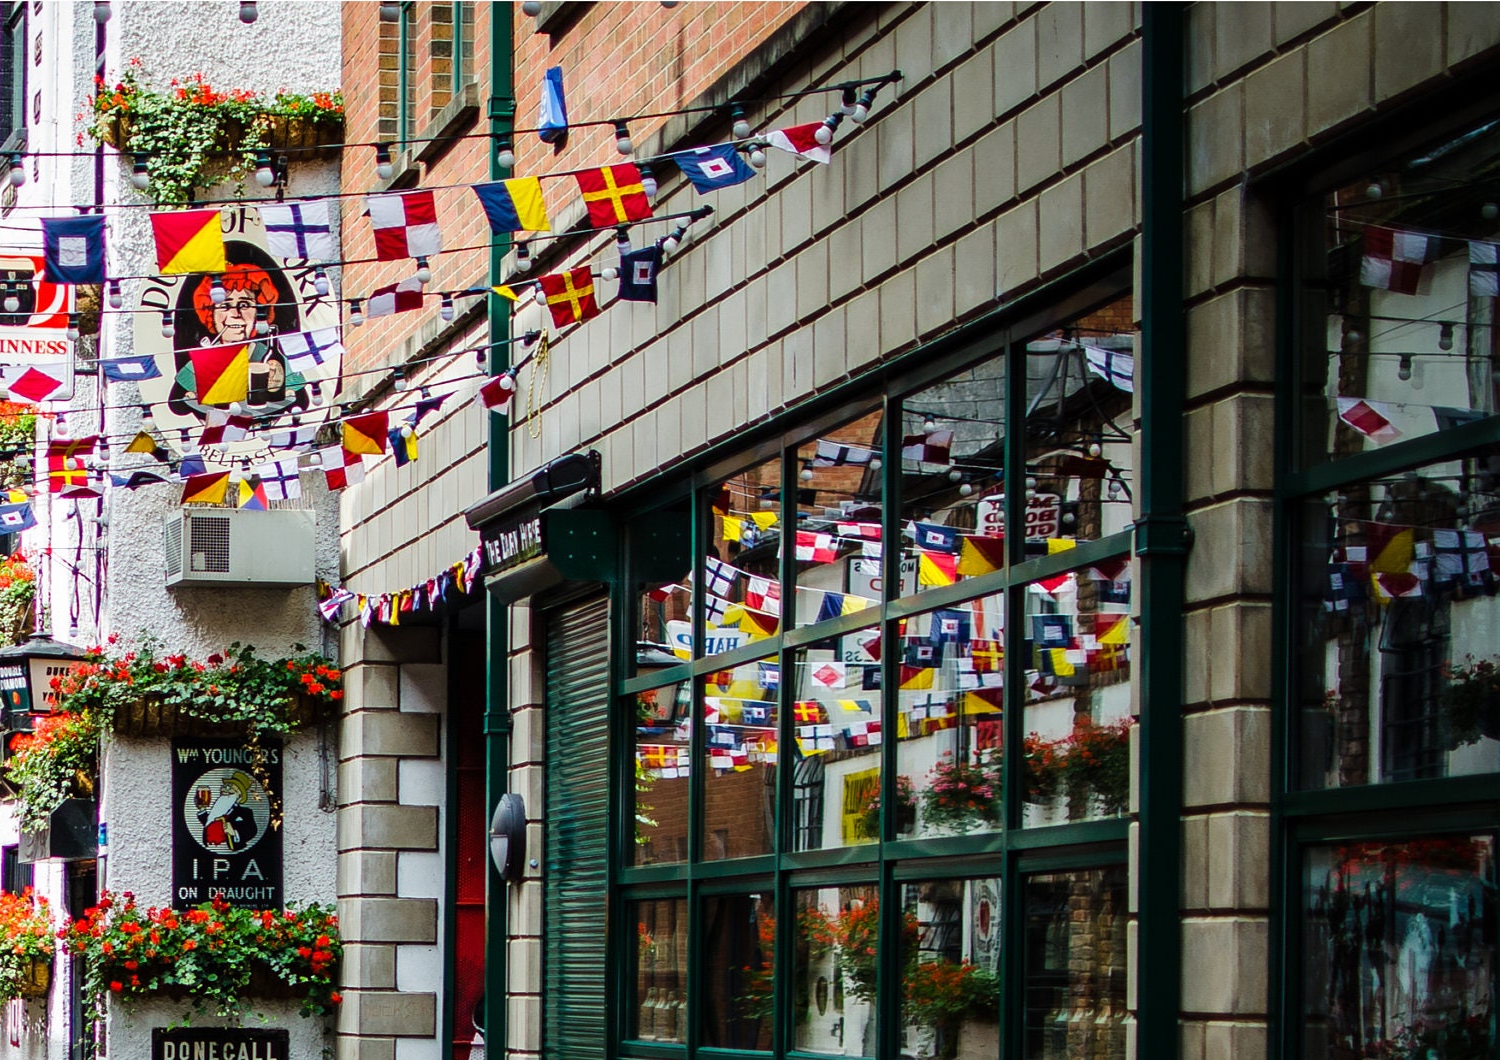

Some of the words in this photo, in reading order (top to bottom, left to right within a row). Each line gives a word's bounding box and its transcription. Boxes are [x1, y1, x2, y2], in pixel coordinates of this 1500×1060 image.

[199, 444, 276, 468] BELFAST
[178, 887, 198, 900] ON
[208, 887, 276, 900] DRAUGHT
